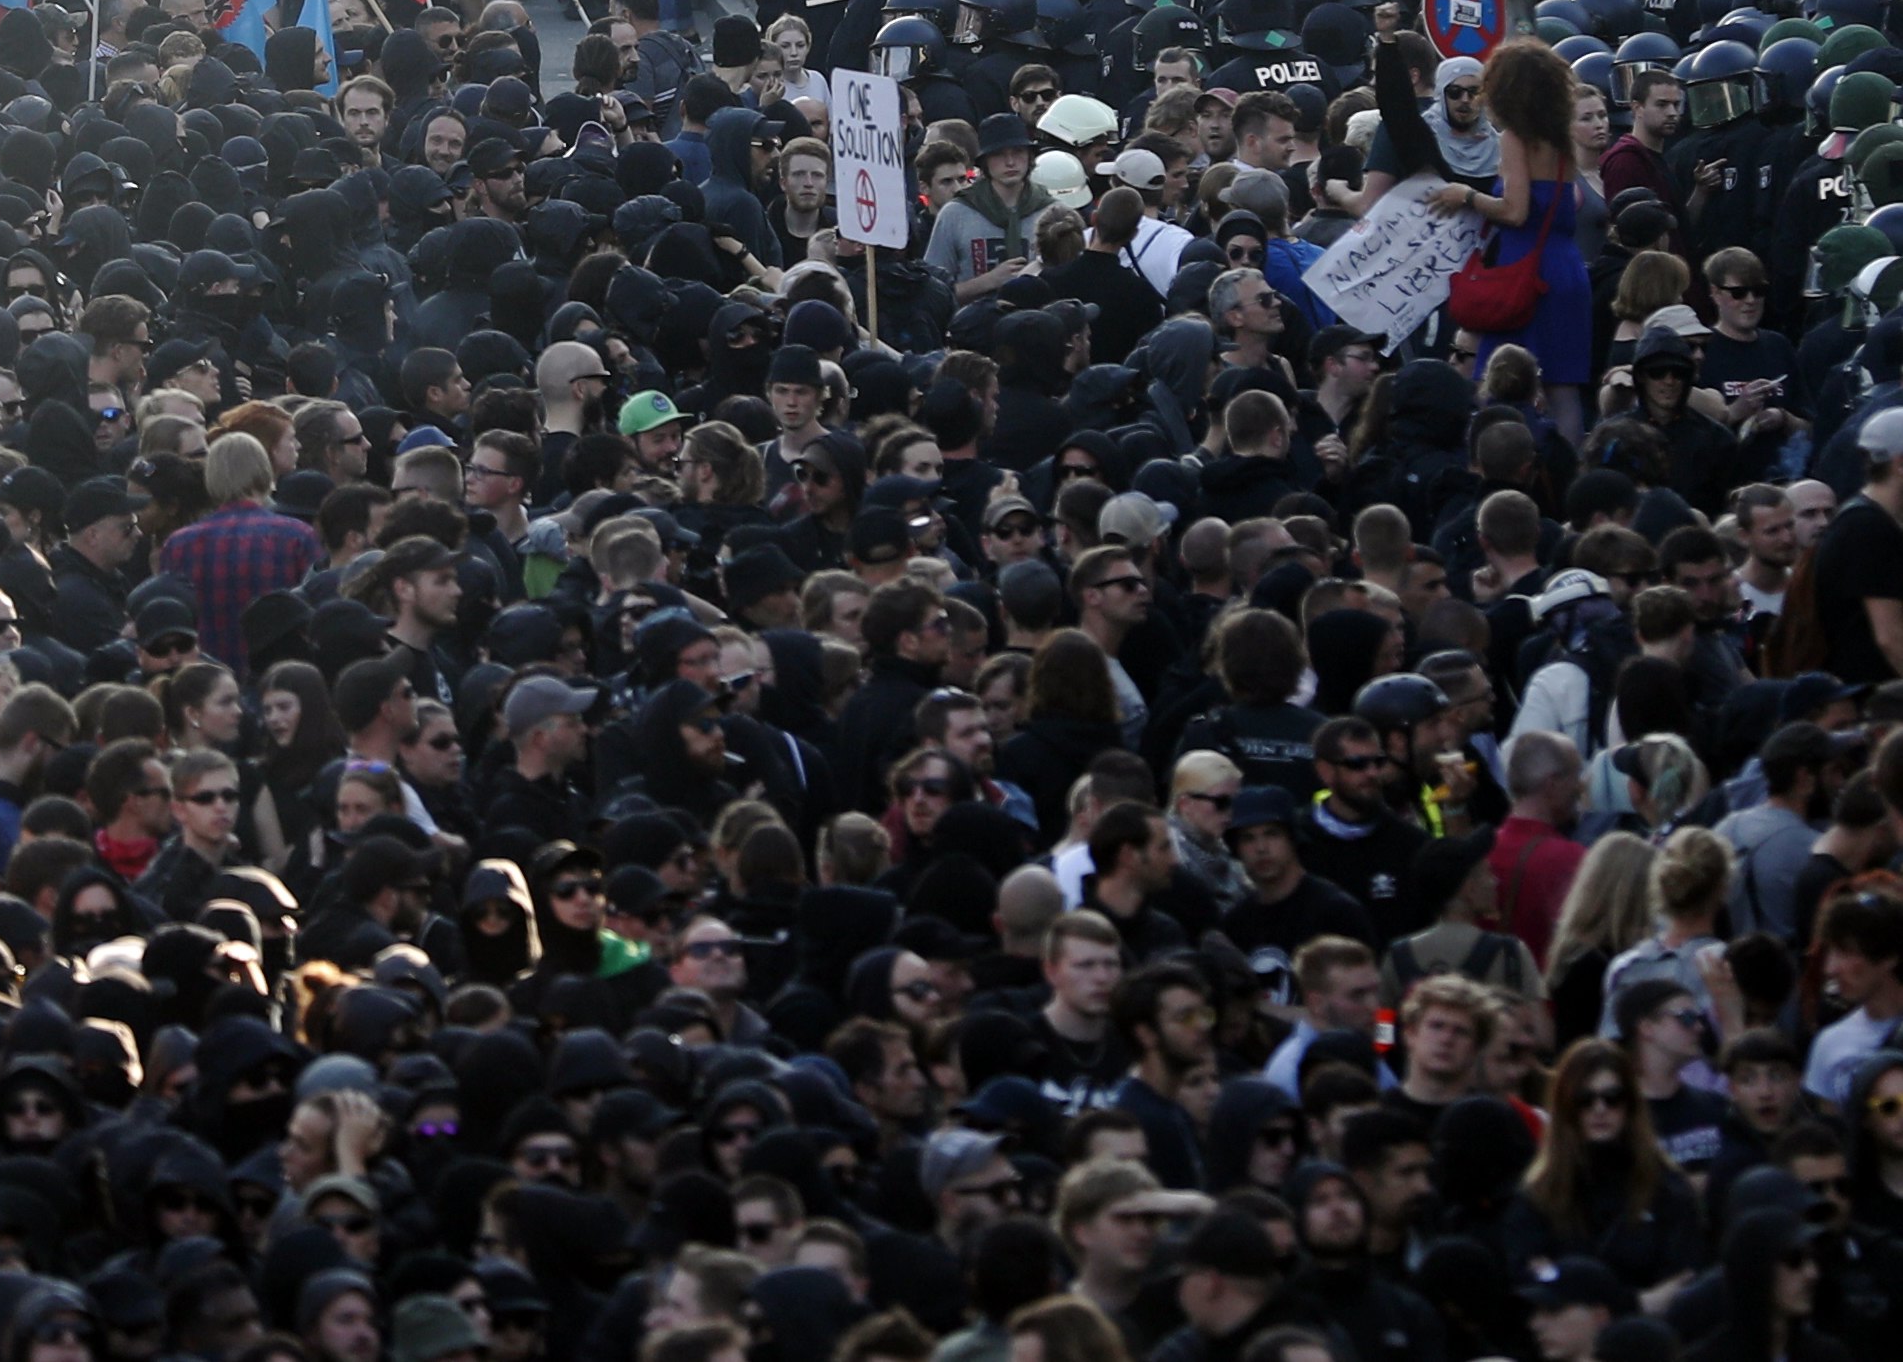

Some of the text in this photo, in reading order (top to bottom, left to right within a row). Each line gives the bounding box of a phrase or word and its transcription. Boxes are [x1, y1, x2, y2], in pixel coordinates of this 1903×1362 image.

[848, 80, 872, 121] ONE
[837, 118, 902, 169] SOLUTION
[1377, 221, 1476, 315] LIBRES
